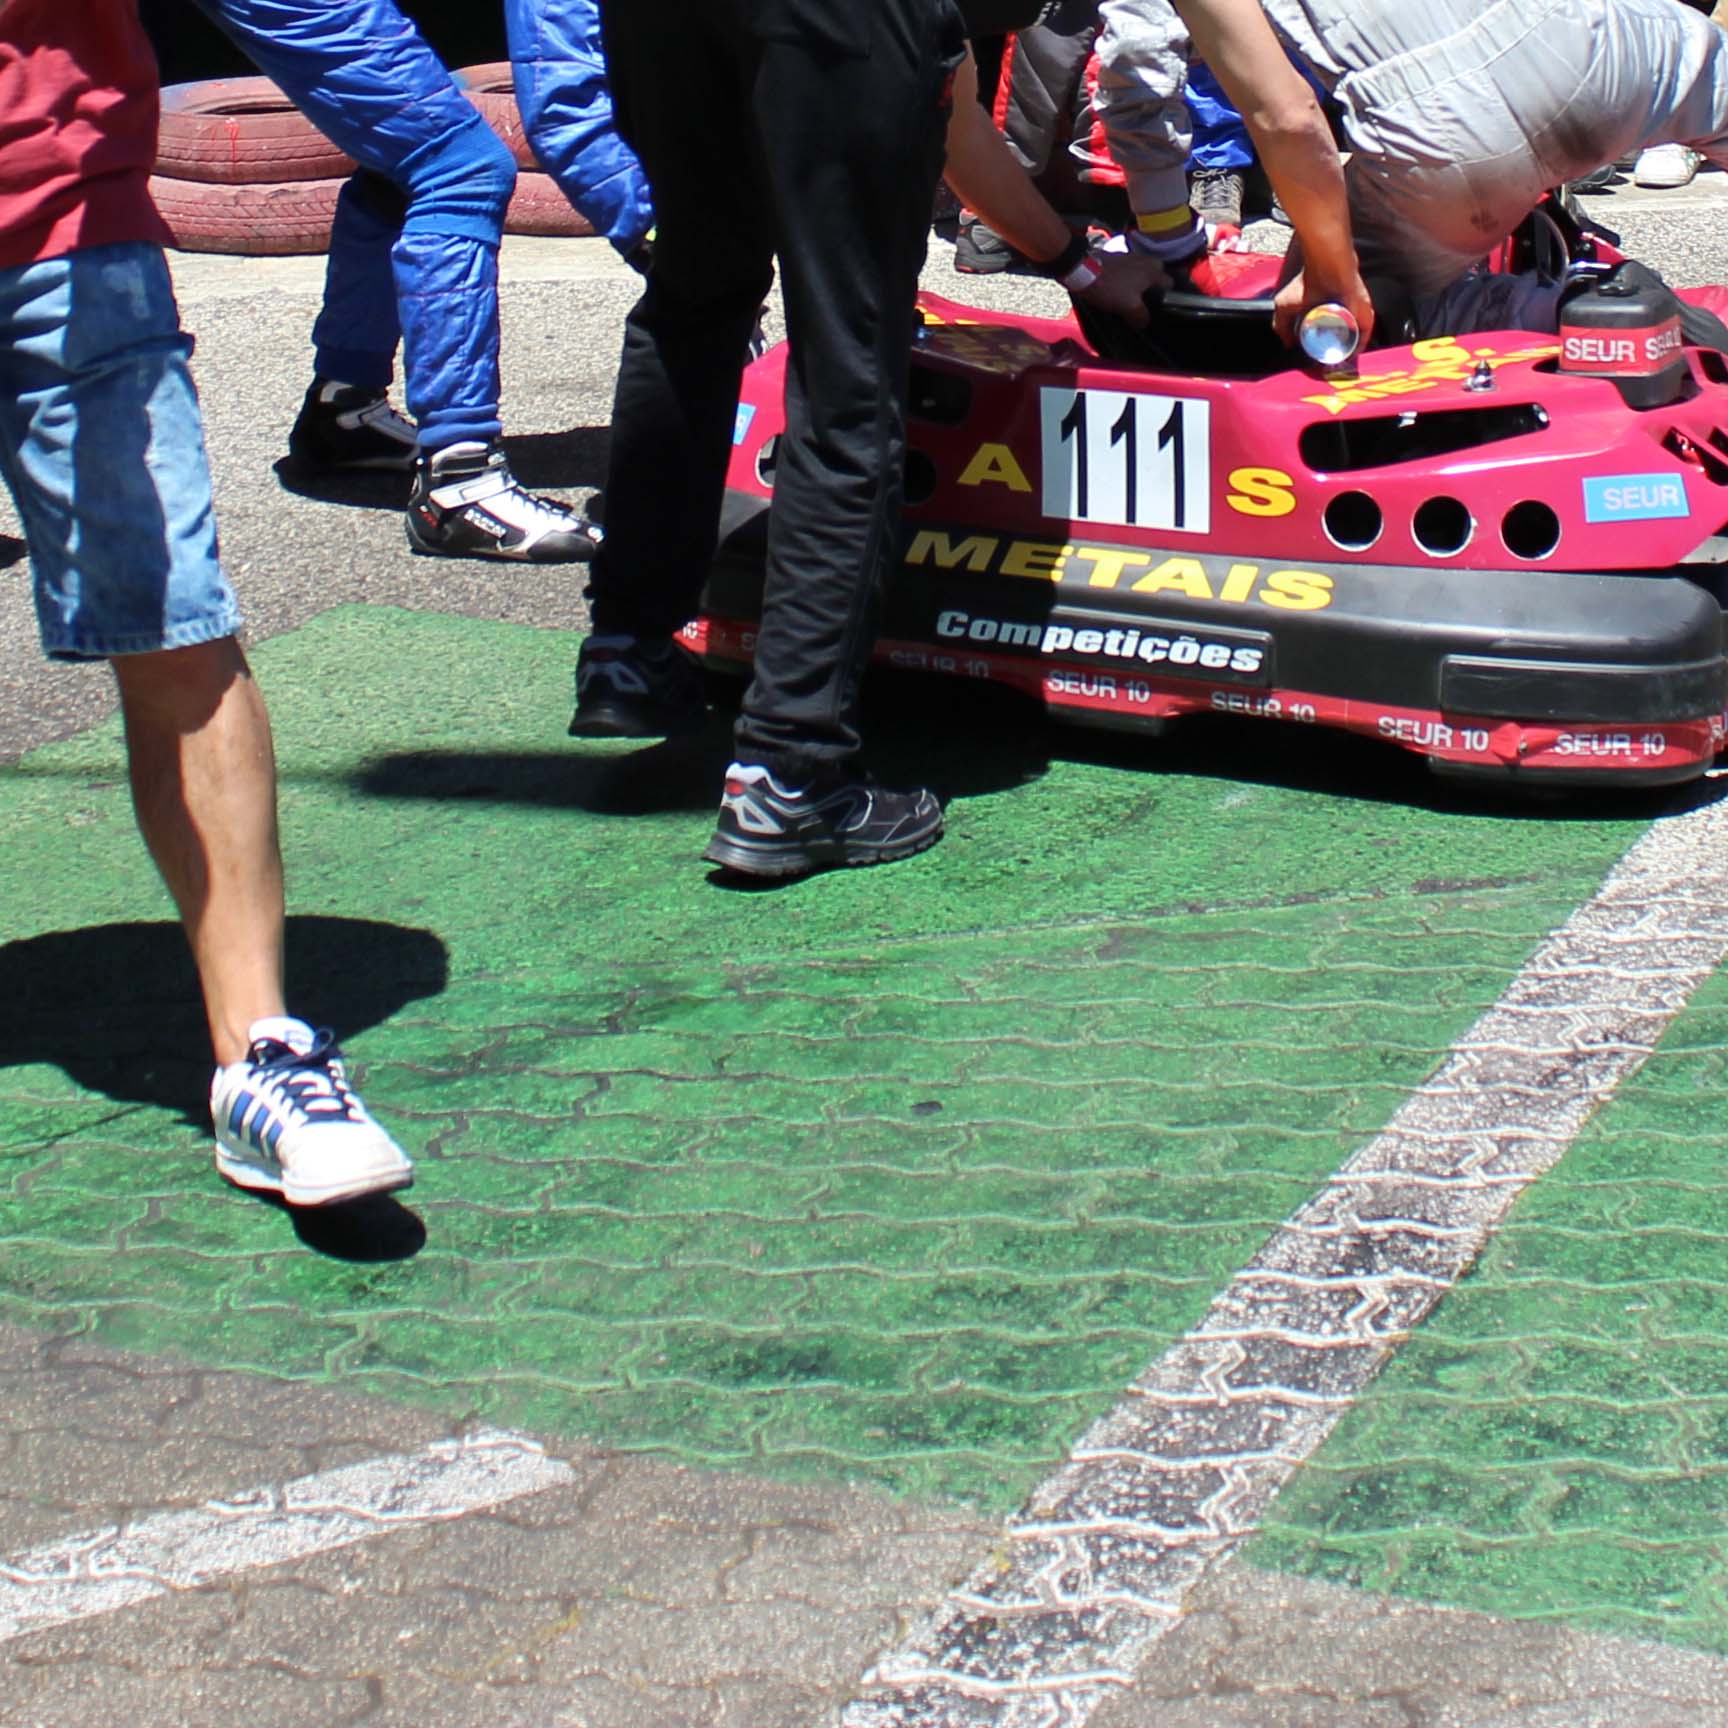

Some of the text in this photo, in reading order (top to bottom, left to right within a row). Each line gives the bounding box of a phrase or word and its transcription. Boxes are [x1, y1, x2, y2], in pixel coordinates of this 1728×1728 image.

[1564, 337, 1636, 364] SEUR
[958, 443, 1033, 492] A
[1060, 391, 1186, 529] 111
[1225, 467, 1297, 517] S
[1603, 483, 1681, 511] SEUR
[904, 530, 1334, 611] METAIS
[936, 610, 1264, 673] Competições
[1046, 670, 1151, 704] SEUR 10
[1209, 690, 1316, 723] SEUR 10
[1377, 716, 1489, 752] SEUR 10
[1557, 733, 1666, 756] SEUR 10
